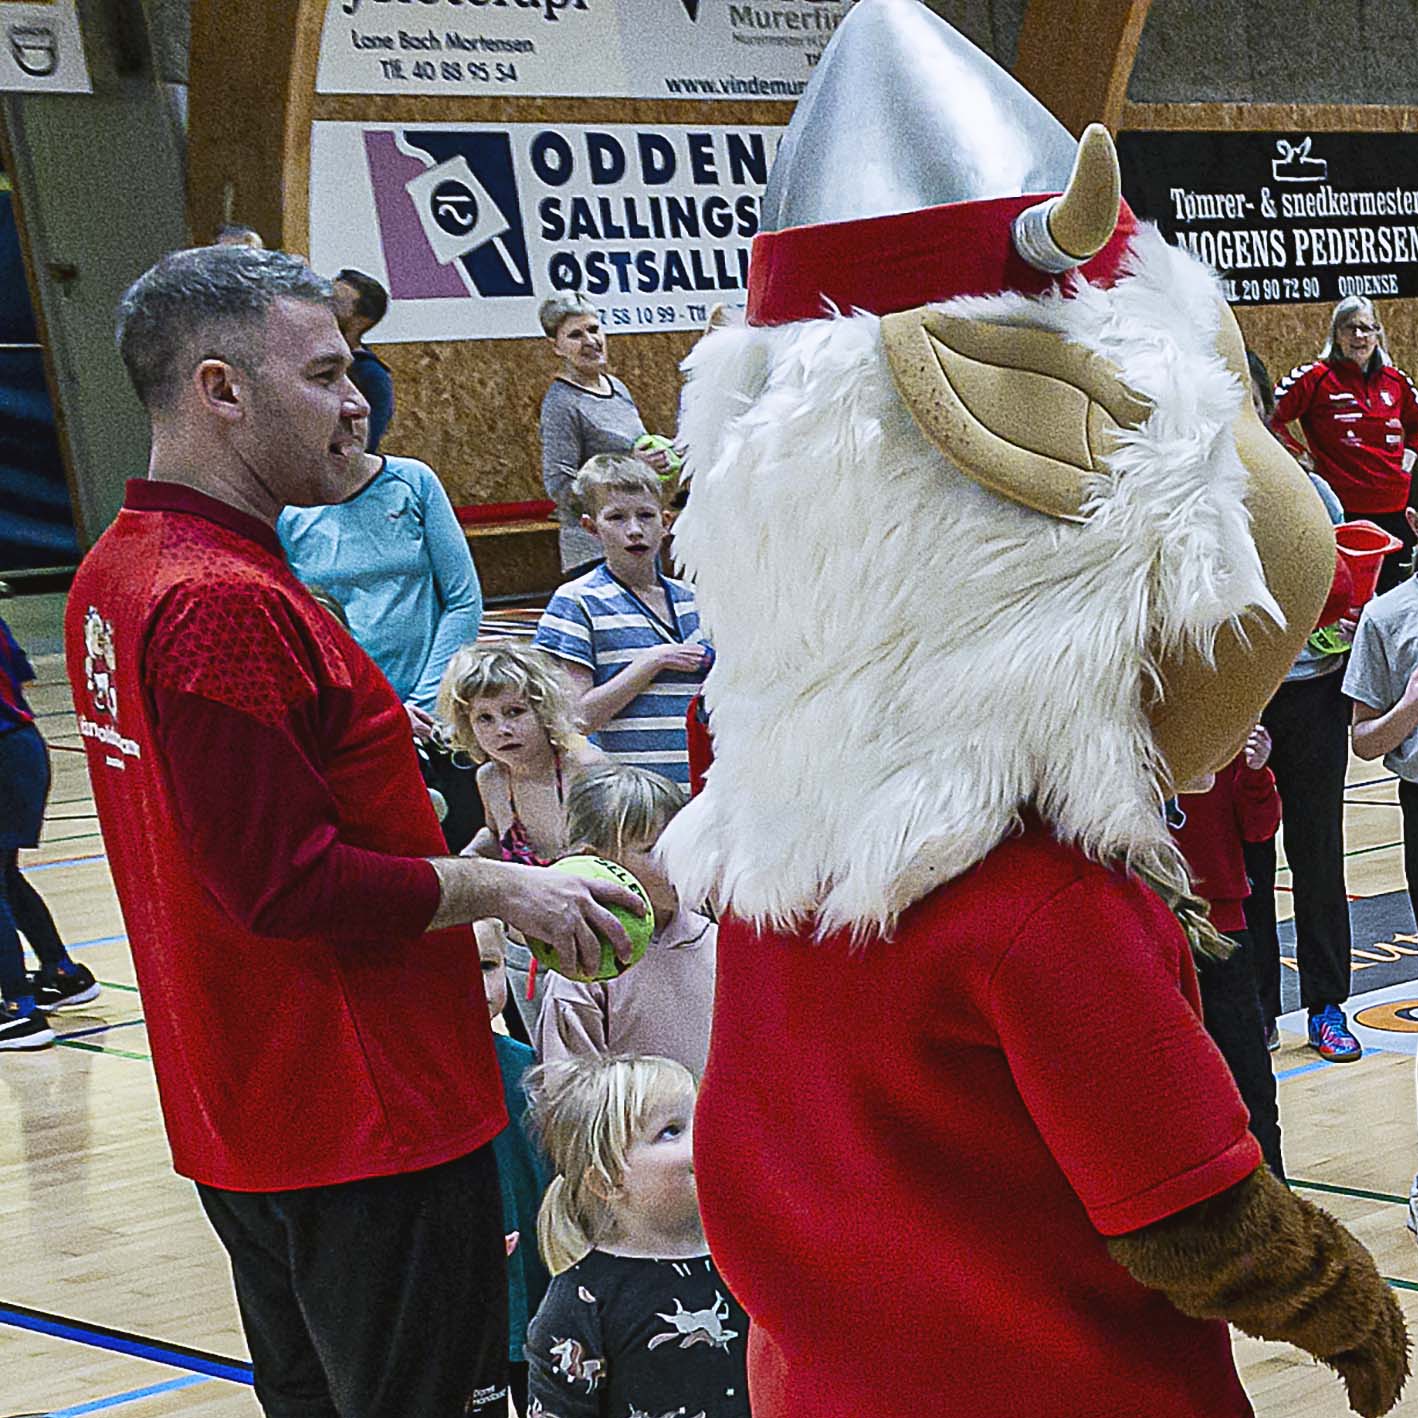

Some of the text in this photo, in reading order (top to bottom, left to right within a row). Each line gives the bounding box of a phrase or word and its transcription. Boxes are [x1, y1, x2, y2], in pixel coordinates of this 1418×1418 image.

[412, 61, 436, 80] 40
[665, 74, 809, 96] www.vindemur
[530, 130, 769, 187] ODDEN
[539, 195, 761, 242] SALLINGS
[1170, 187, 1254, 223] Tømrer-
[1261, 186, 1278, 219] &
[549, 248, 749, 296] ØSTSALLI
[1243, 279, 1260, 301] 20
[1263, 278, 1280, 300] 90
[1283, 277, 1300, 299] 72
[1303, 276, 1320, 298] 90
[1338, 274, 1399, 297] ODDENSE
